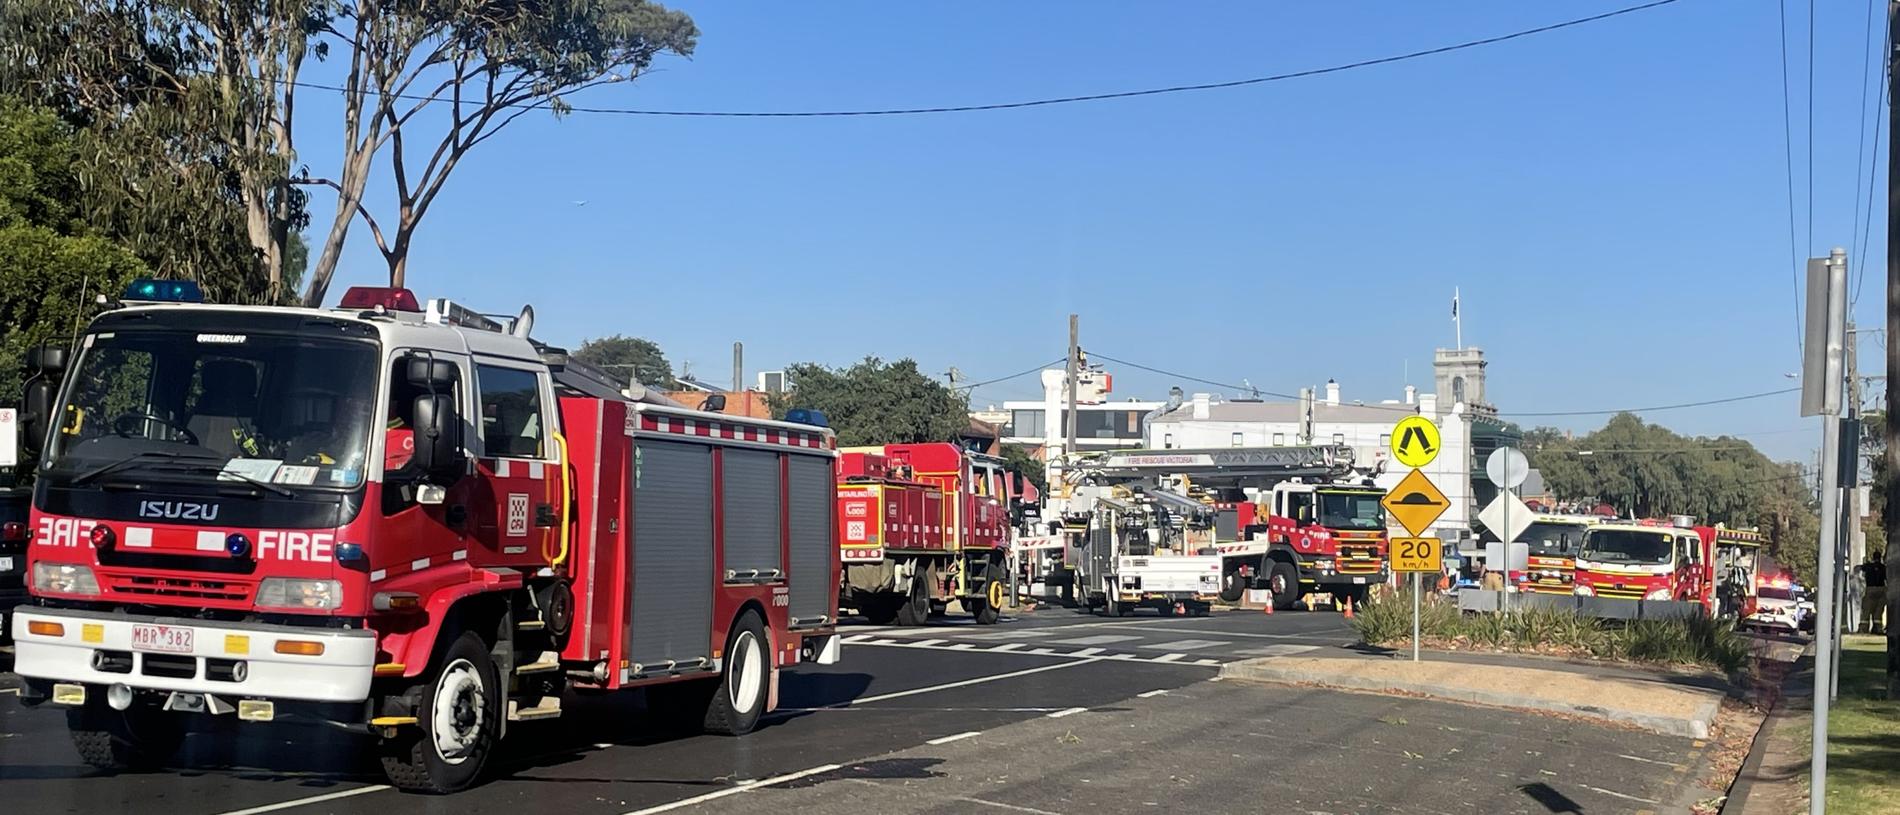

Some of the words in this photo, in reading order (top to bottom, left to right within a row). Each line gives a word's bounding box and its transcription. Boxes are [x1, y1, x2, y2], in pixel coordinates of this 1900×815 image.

[196, 334, 247, 343] QUEENSCLIFF
[1142, 456, 1165, 464] RESCUE
[1167, 456, 1193, 464] VICTORIA
[139, 500, 219, 520] ISUZU
[511, 519, 524, 530] CFA
[1313, 531, 1330, 539] FIRE
[257, 530, 334, 562] FIRE
[1400, 541, 1431, 559] 20
[1402, 560, 1429, 569] km/h
[135, 628, 157, 644] MBR
[168, 630, 191, 647] 382
